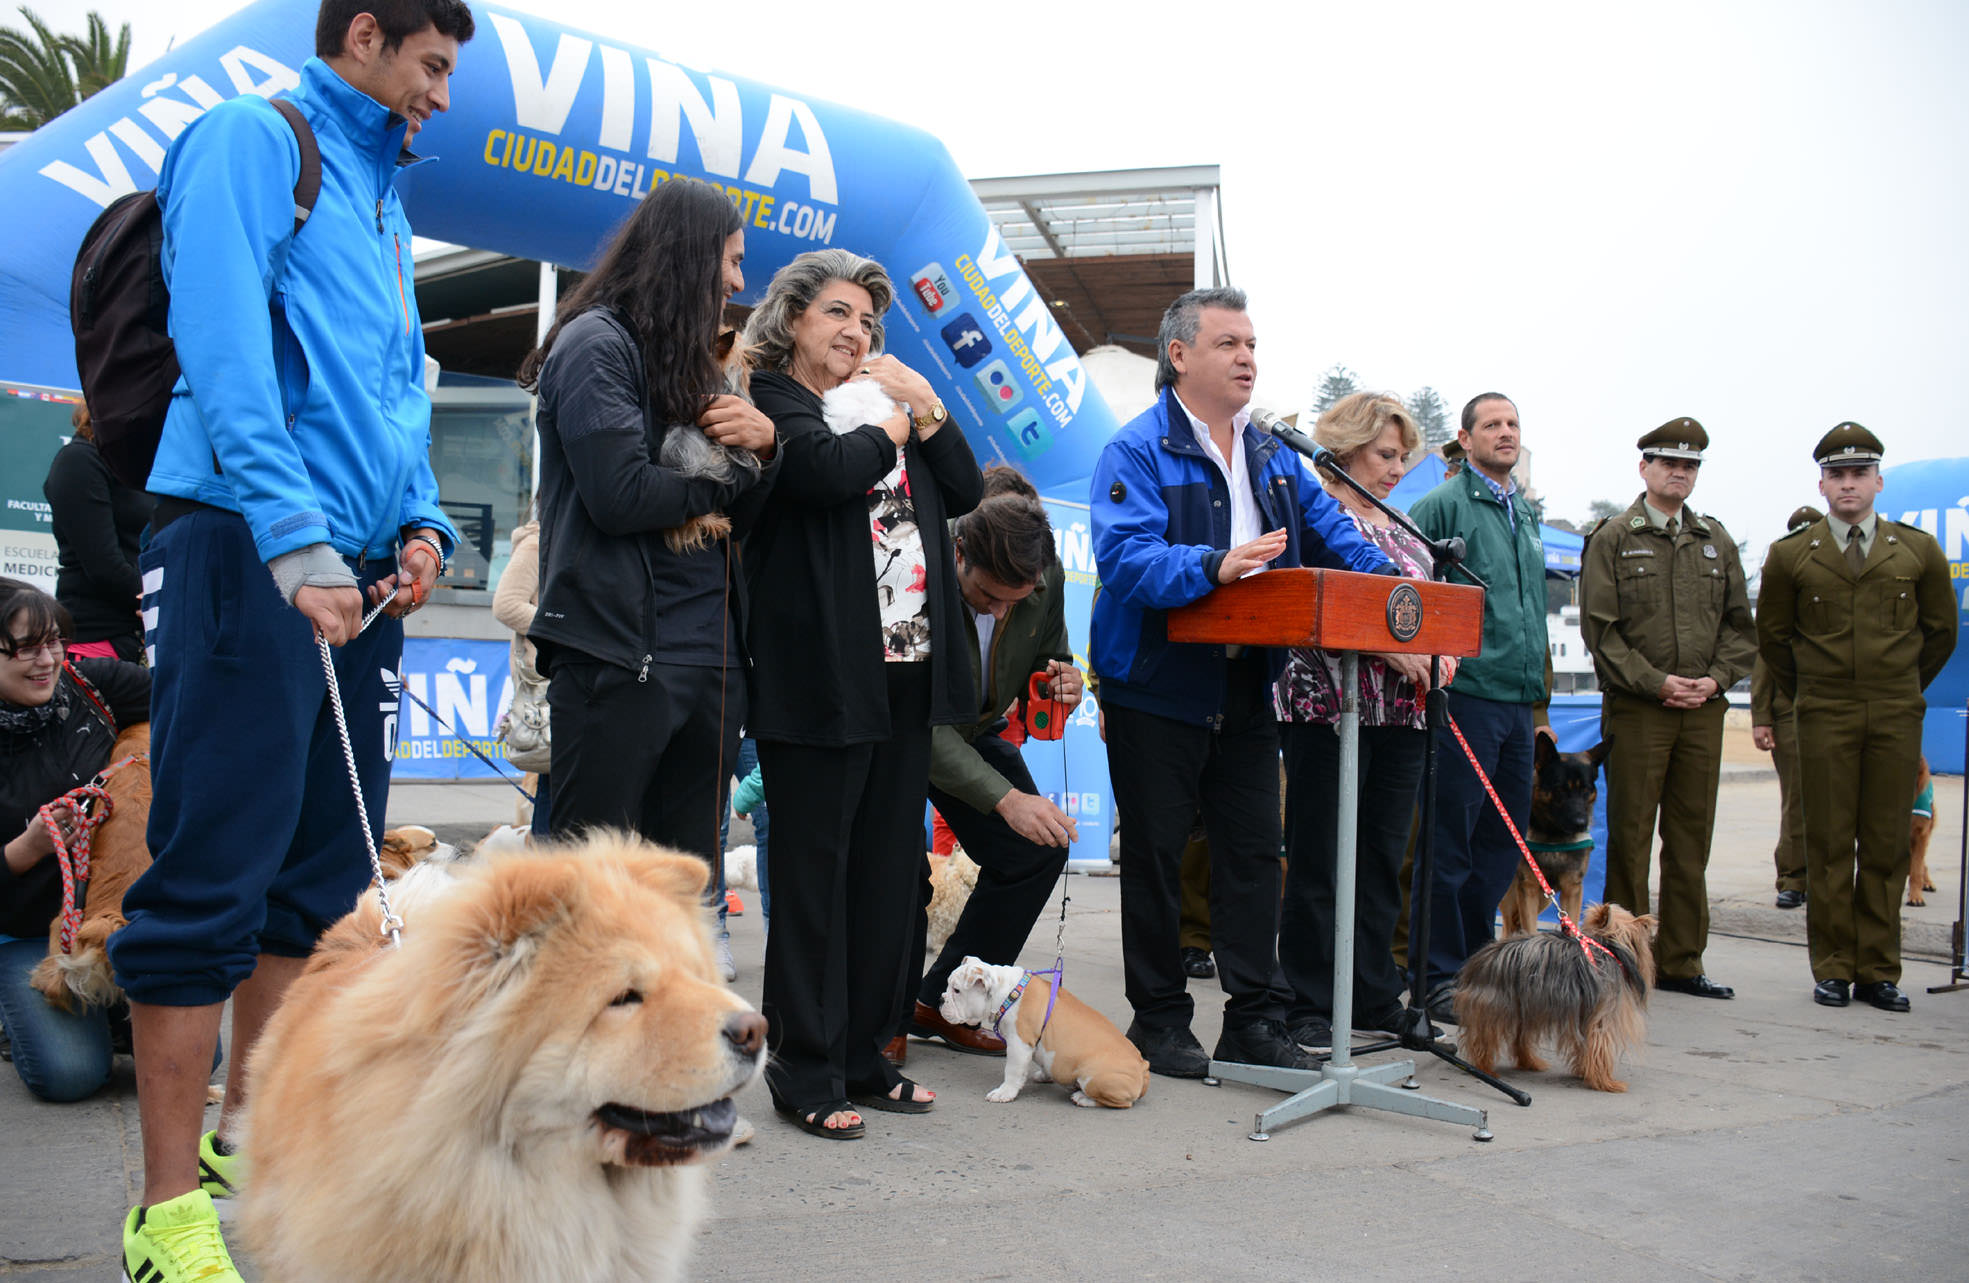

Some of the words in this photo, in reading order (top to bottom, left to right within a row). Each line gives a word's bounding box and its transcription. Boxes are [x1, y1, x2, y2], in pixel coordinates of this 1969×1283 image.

[919, 281, 938, 307] Tube
[934, 274, 950, 297] You
[7, 499, 52, 513] FACULTA
[4, 562, 59, 577] MEDICI
